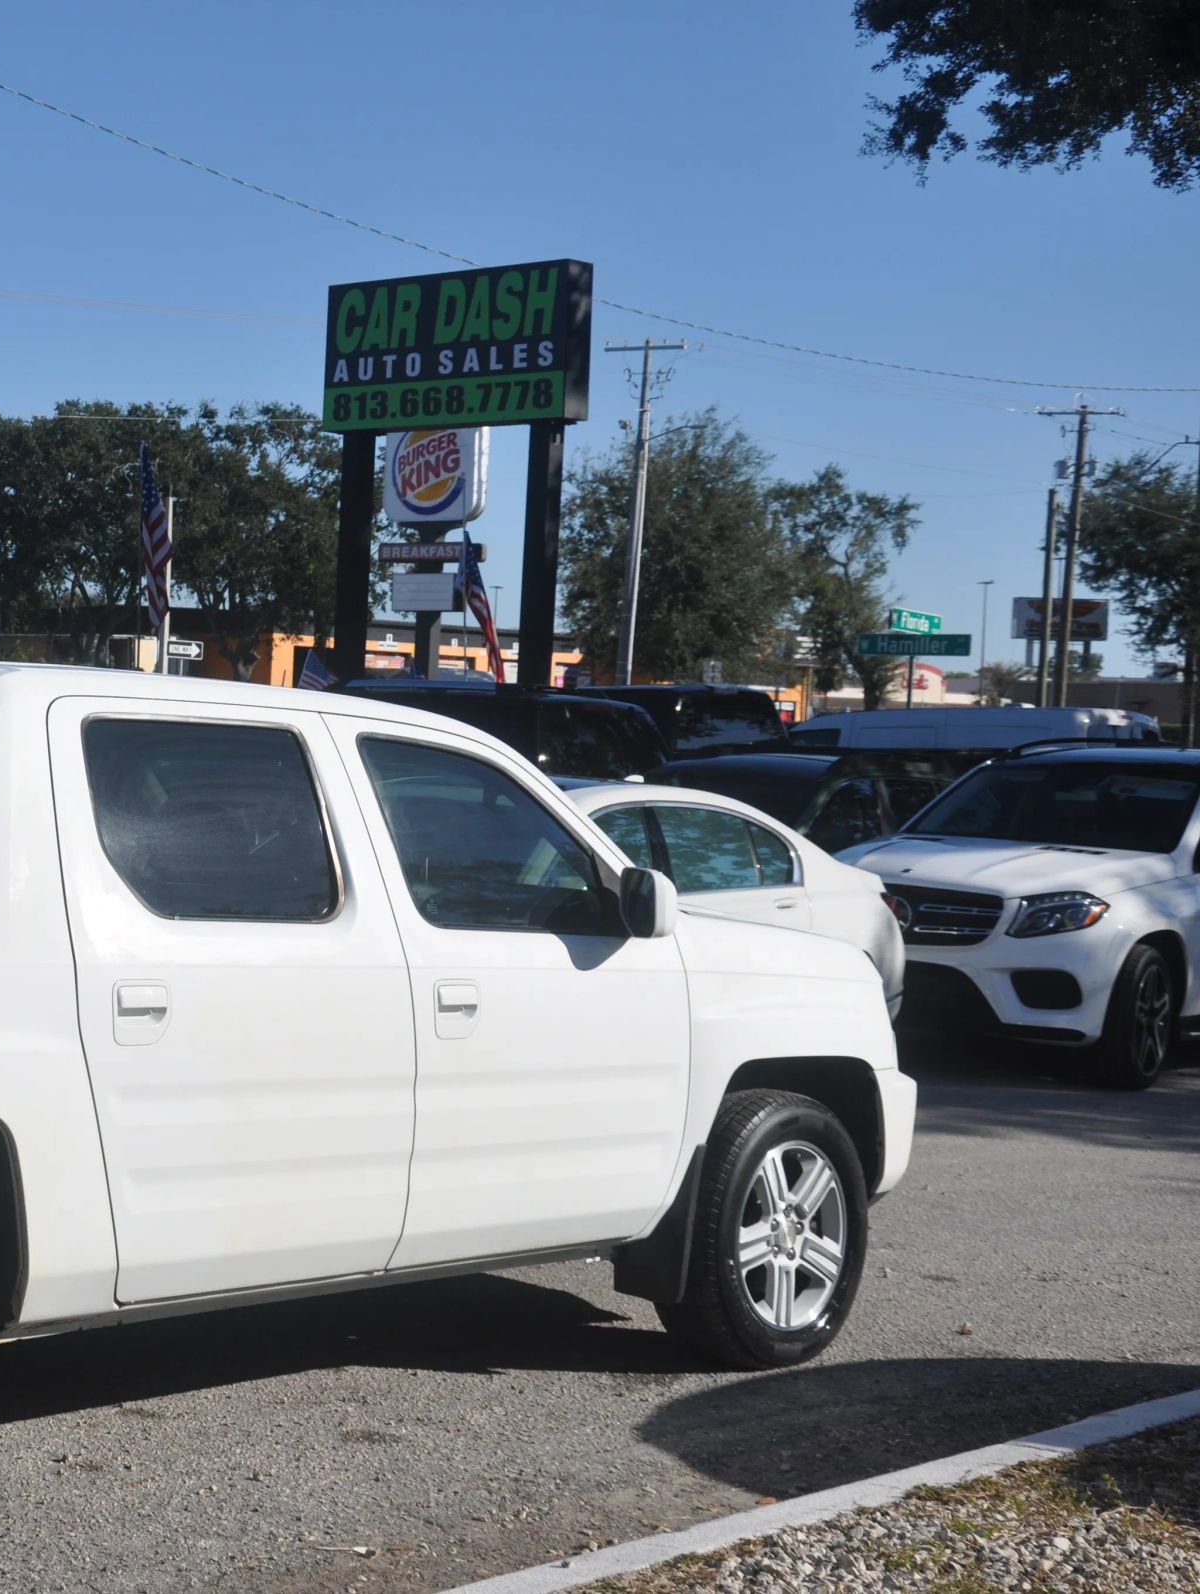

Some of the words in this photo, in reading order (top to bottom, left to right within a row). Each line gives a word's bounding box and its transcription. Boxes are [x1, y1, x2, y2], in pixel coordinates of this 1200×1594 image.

[337, 284, 421, 353] CAR
[433, 268, 559, 344] DASH
[333, 353, 421, 383] AUTO
[438, 341, 554, 374] SALES
[333, 378, 553, 422] 813.668.7778
[398, 432, 458, 474] BURGER
[400, 448, 461, 498] KING
[382, 545, 462, 559] BREAKFAST
[901, 611, 930, 632] Florida
[877, 636, 948, 654] Hamiller
